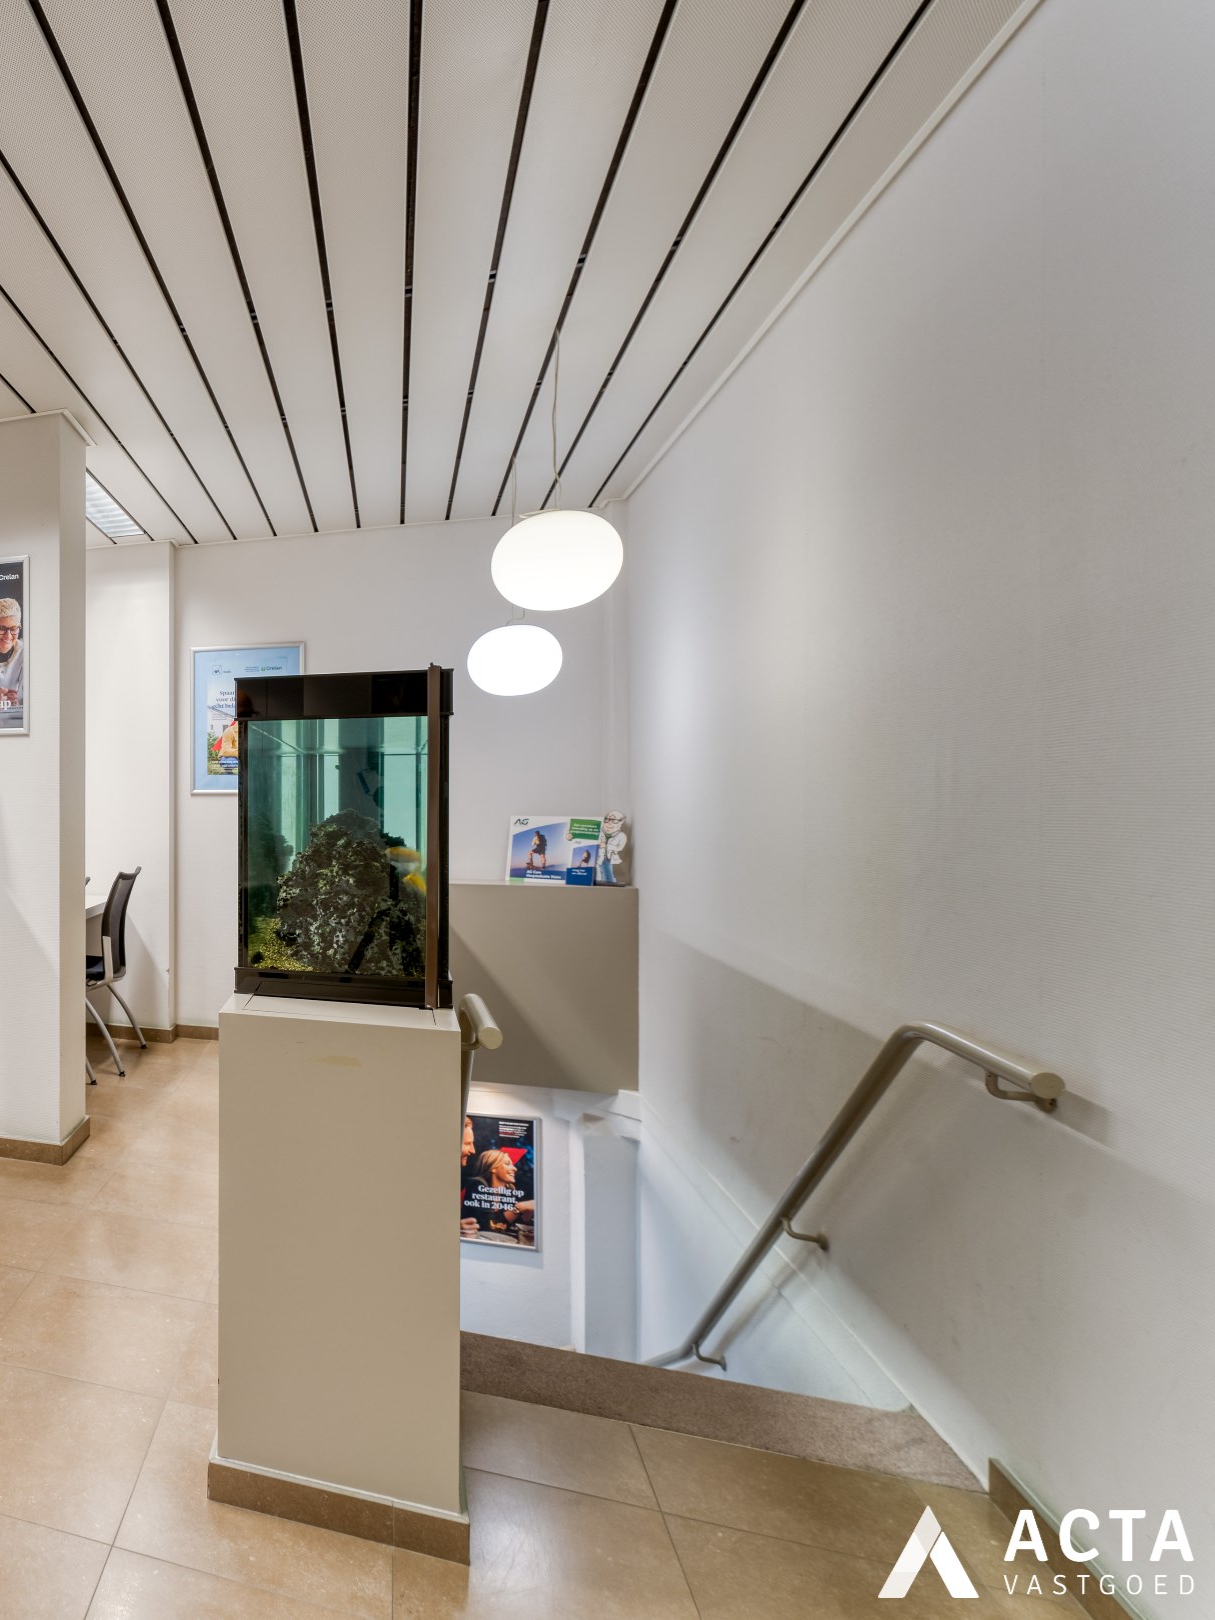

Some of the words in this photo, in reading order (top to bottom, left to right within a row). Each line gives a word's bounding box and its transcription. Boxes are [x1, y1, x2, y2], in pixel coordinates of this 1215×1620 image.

[477, 1185, 511, 1196] Gezellig
[512, 1190, 524, 1198] op
[464, 1200, 480, 1208] ook
